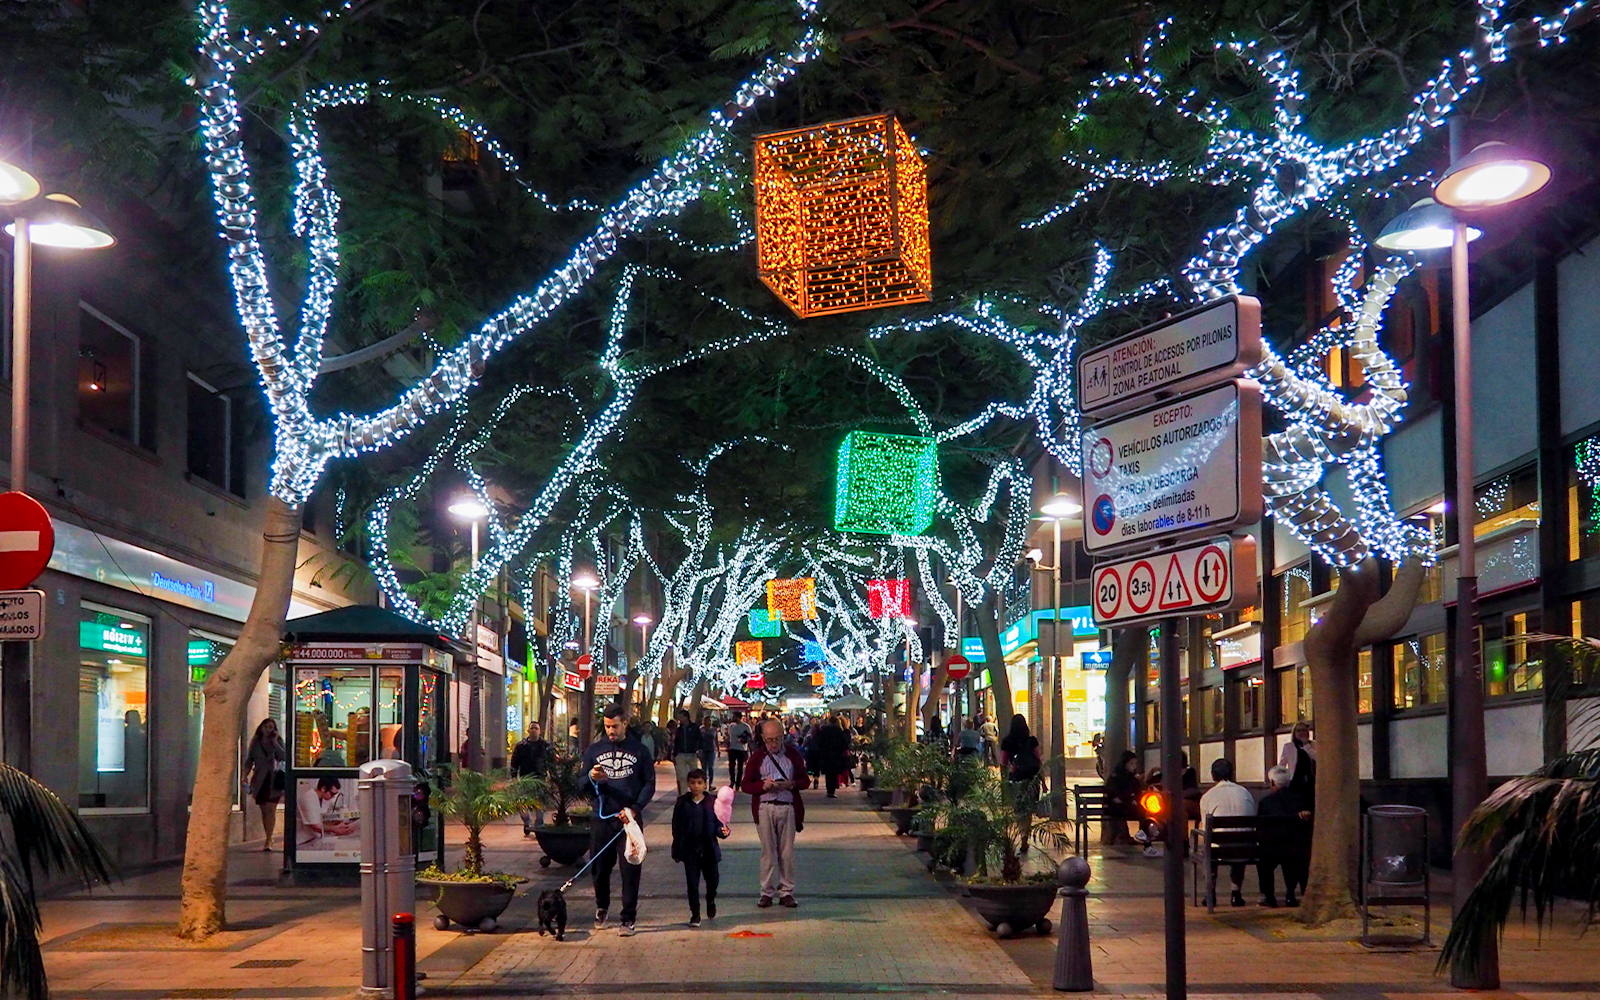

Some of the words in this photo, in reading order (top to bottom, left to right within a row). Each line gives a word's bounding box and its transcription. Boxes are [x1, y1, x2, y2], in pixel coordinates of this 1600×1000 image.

[1112, 337, 1156, 364] ATENCIÓN:
[1112, 357, 1142, 380] CONTROL
[1144, 354, 1152, 368] DE
[1154, 342, 1184, 364] ACCESOS
[1186, 336, 1200, 353] POR
[1202, 324, 1232, 348] PILONAS
[1112, 378, 1136, 396] ZONA
[1138, 362, 1182, 386] PEATONAL
[1154, 404, 1192, 428] EXCEPTO:
[1118, 435, 1162, 458] VEHÍCULOS
[1162, 416, 1222, 446] AUTORIZADOS
[1223, 415, 1229, 427] Y
[1119, 461, 1140, 476] TAXIS
[1120, 480, 1146, 496] CARGA
[1147, 479, 1152, 490] Y
[1154, 466, 1199, 490] DESCARGA
[1152, 490, 1196, 510] delimitadas
[1137, 514, 1174, 533] laborables
[1176, 510, 1186, 524] de
[1187, 506, 1202, 521] 8-11
[1204, 504, 1210, 518] h
[154, 572, 186, 595] Deutsche
[186, 582, 203, 600] Bank
[1100, 584, 1116, 602] 20
